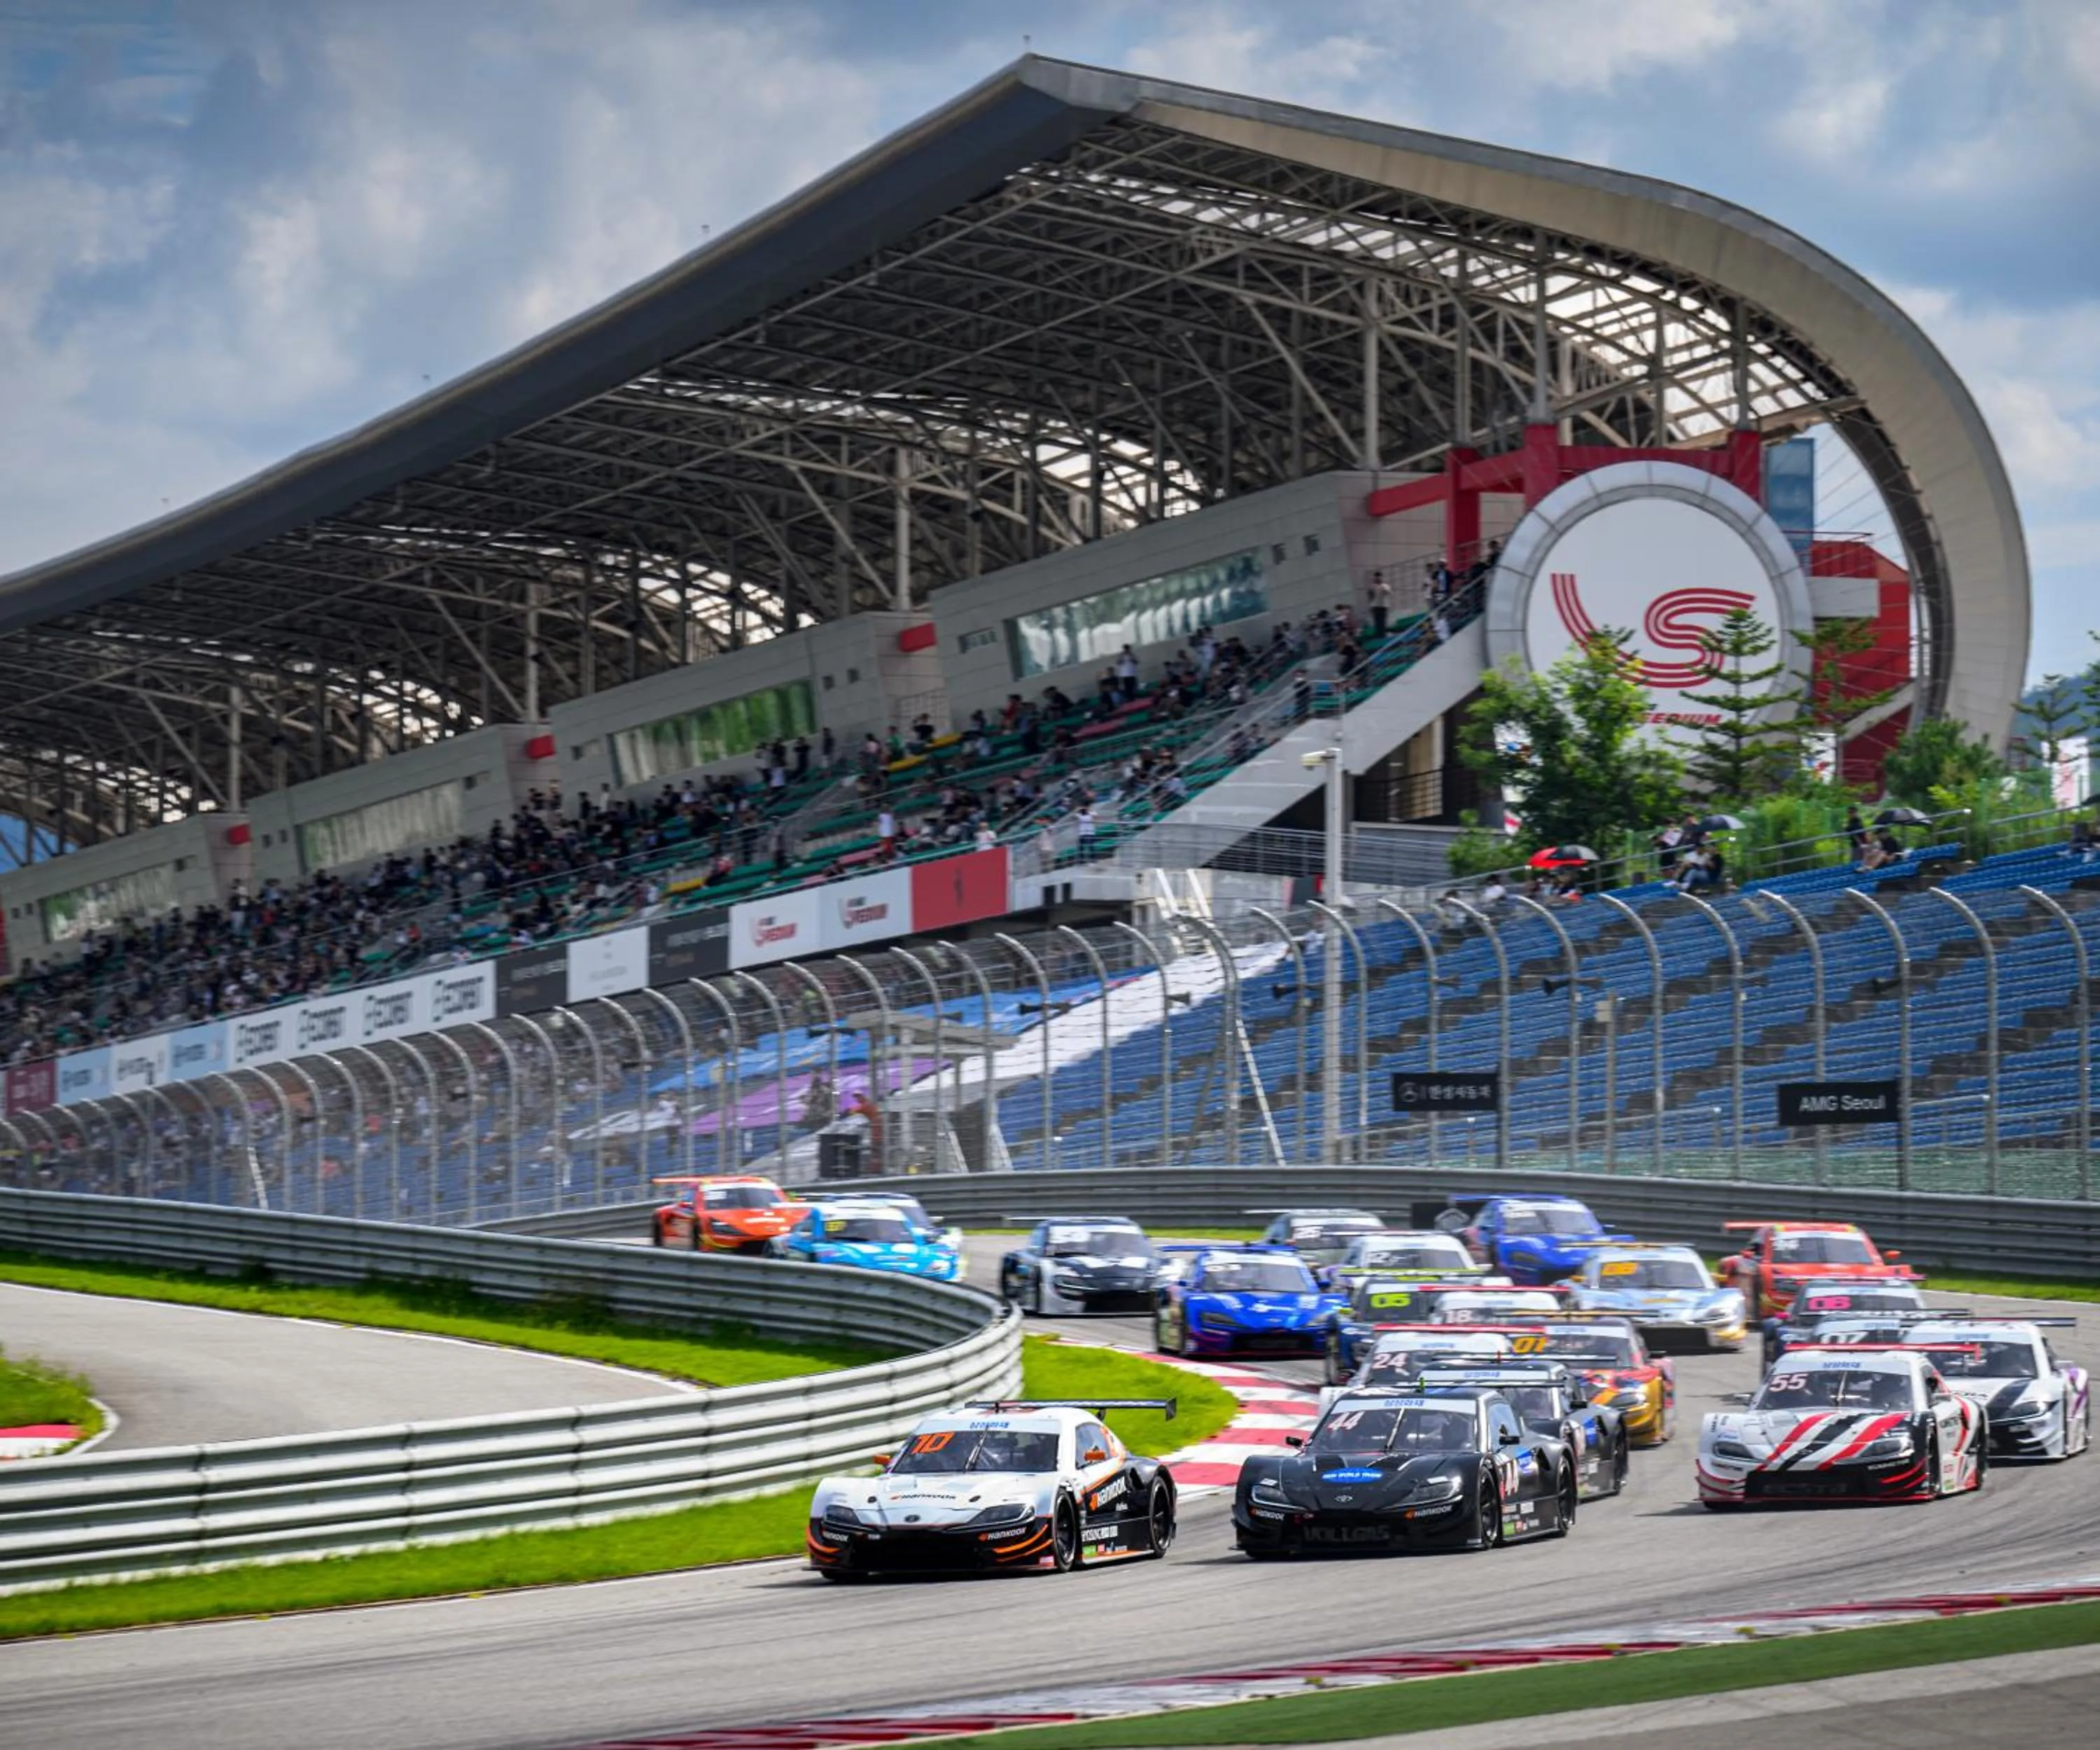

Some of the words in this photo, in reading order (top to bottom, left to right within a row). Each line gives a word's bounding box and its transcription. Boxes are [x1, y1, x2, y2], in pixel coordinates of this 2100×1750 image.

[1799, 1096, 1837, 1112] AMG
[1841, 1094, 1886, 1110] Seoul
[1445, 1309, 1472, 1324] 18
[1372, 1352, 1408, 1369] 24
[1769, 1373, 1809, 1392] 55
[1328, 1411, 1365, 1430] 44
[911, 1431, 955, 1454] 10
